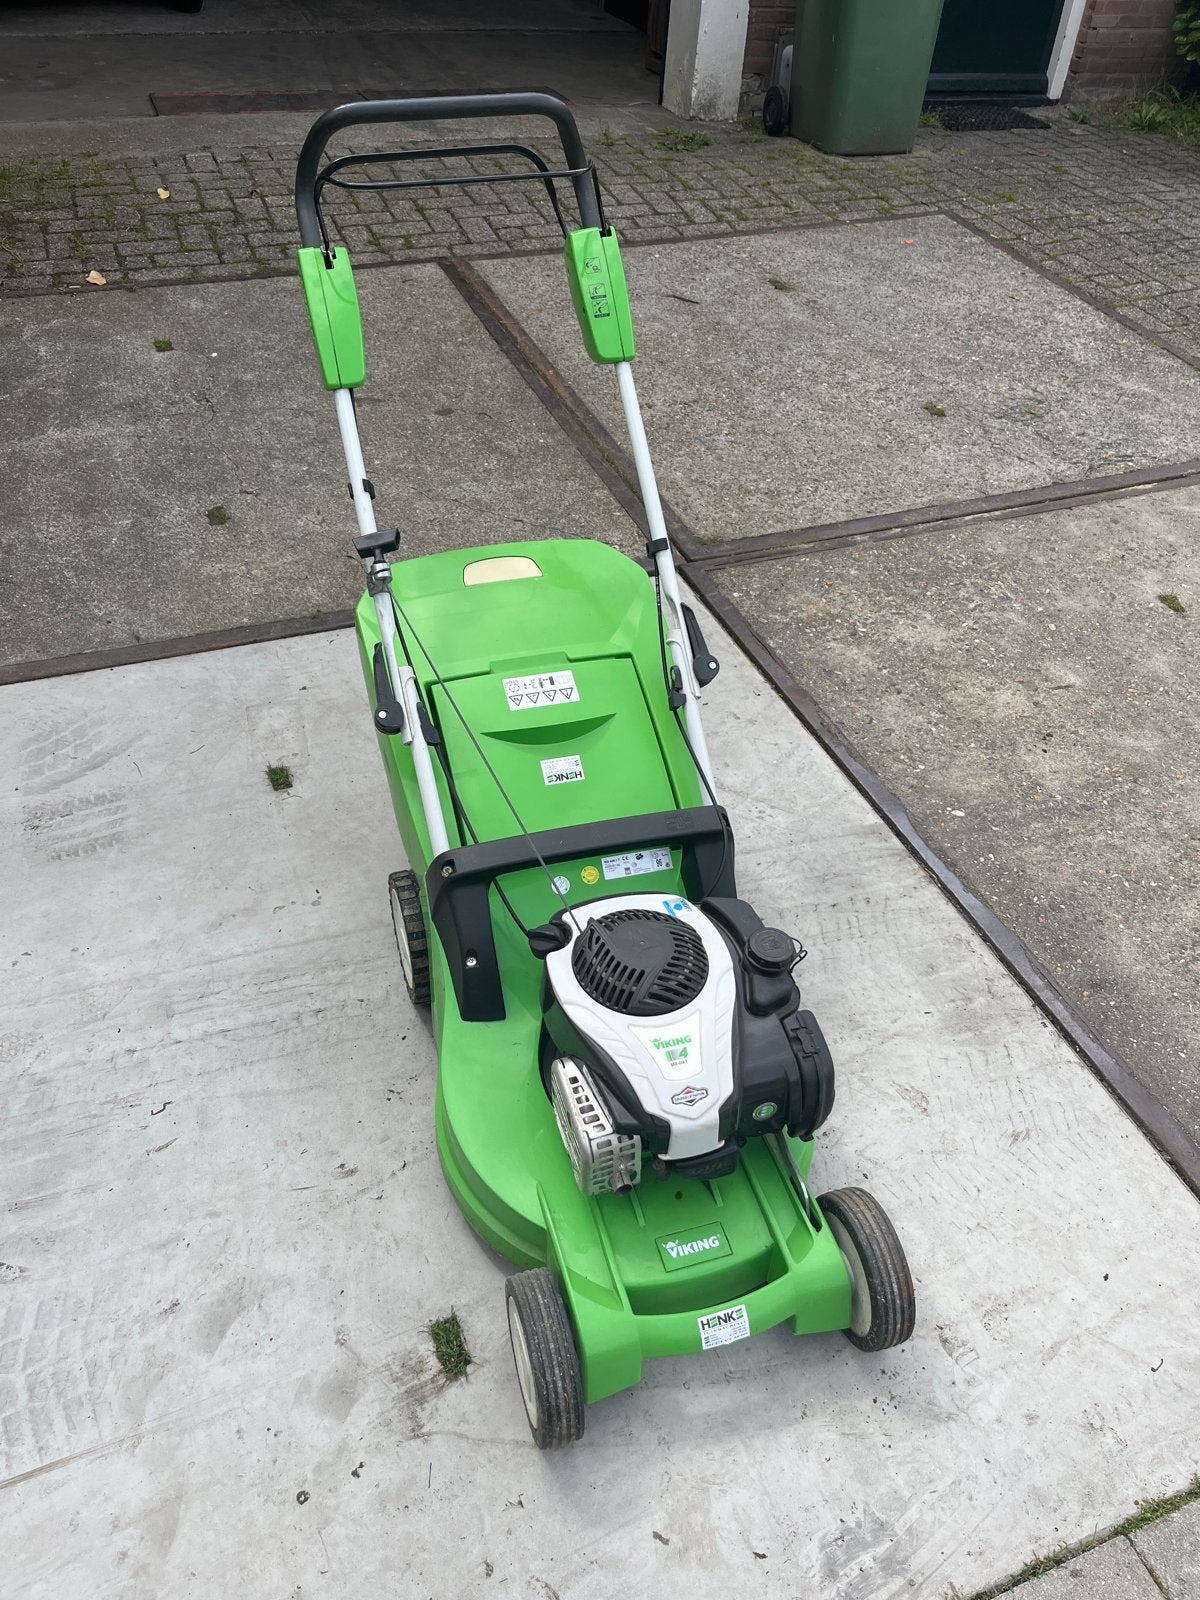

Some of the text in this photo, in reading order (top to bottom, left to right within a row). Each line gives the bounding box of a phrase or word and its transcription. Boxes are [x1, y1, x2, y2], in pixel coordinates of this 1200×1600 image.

[547, 771, 583, 783] HENKE
[653, 1035, 692, 1050] VIKING
[667, 1236, 719, 1258] VIKING
[701, 1308, 744, 1330] HENKE
